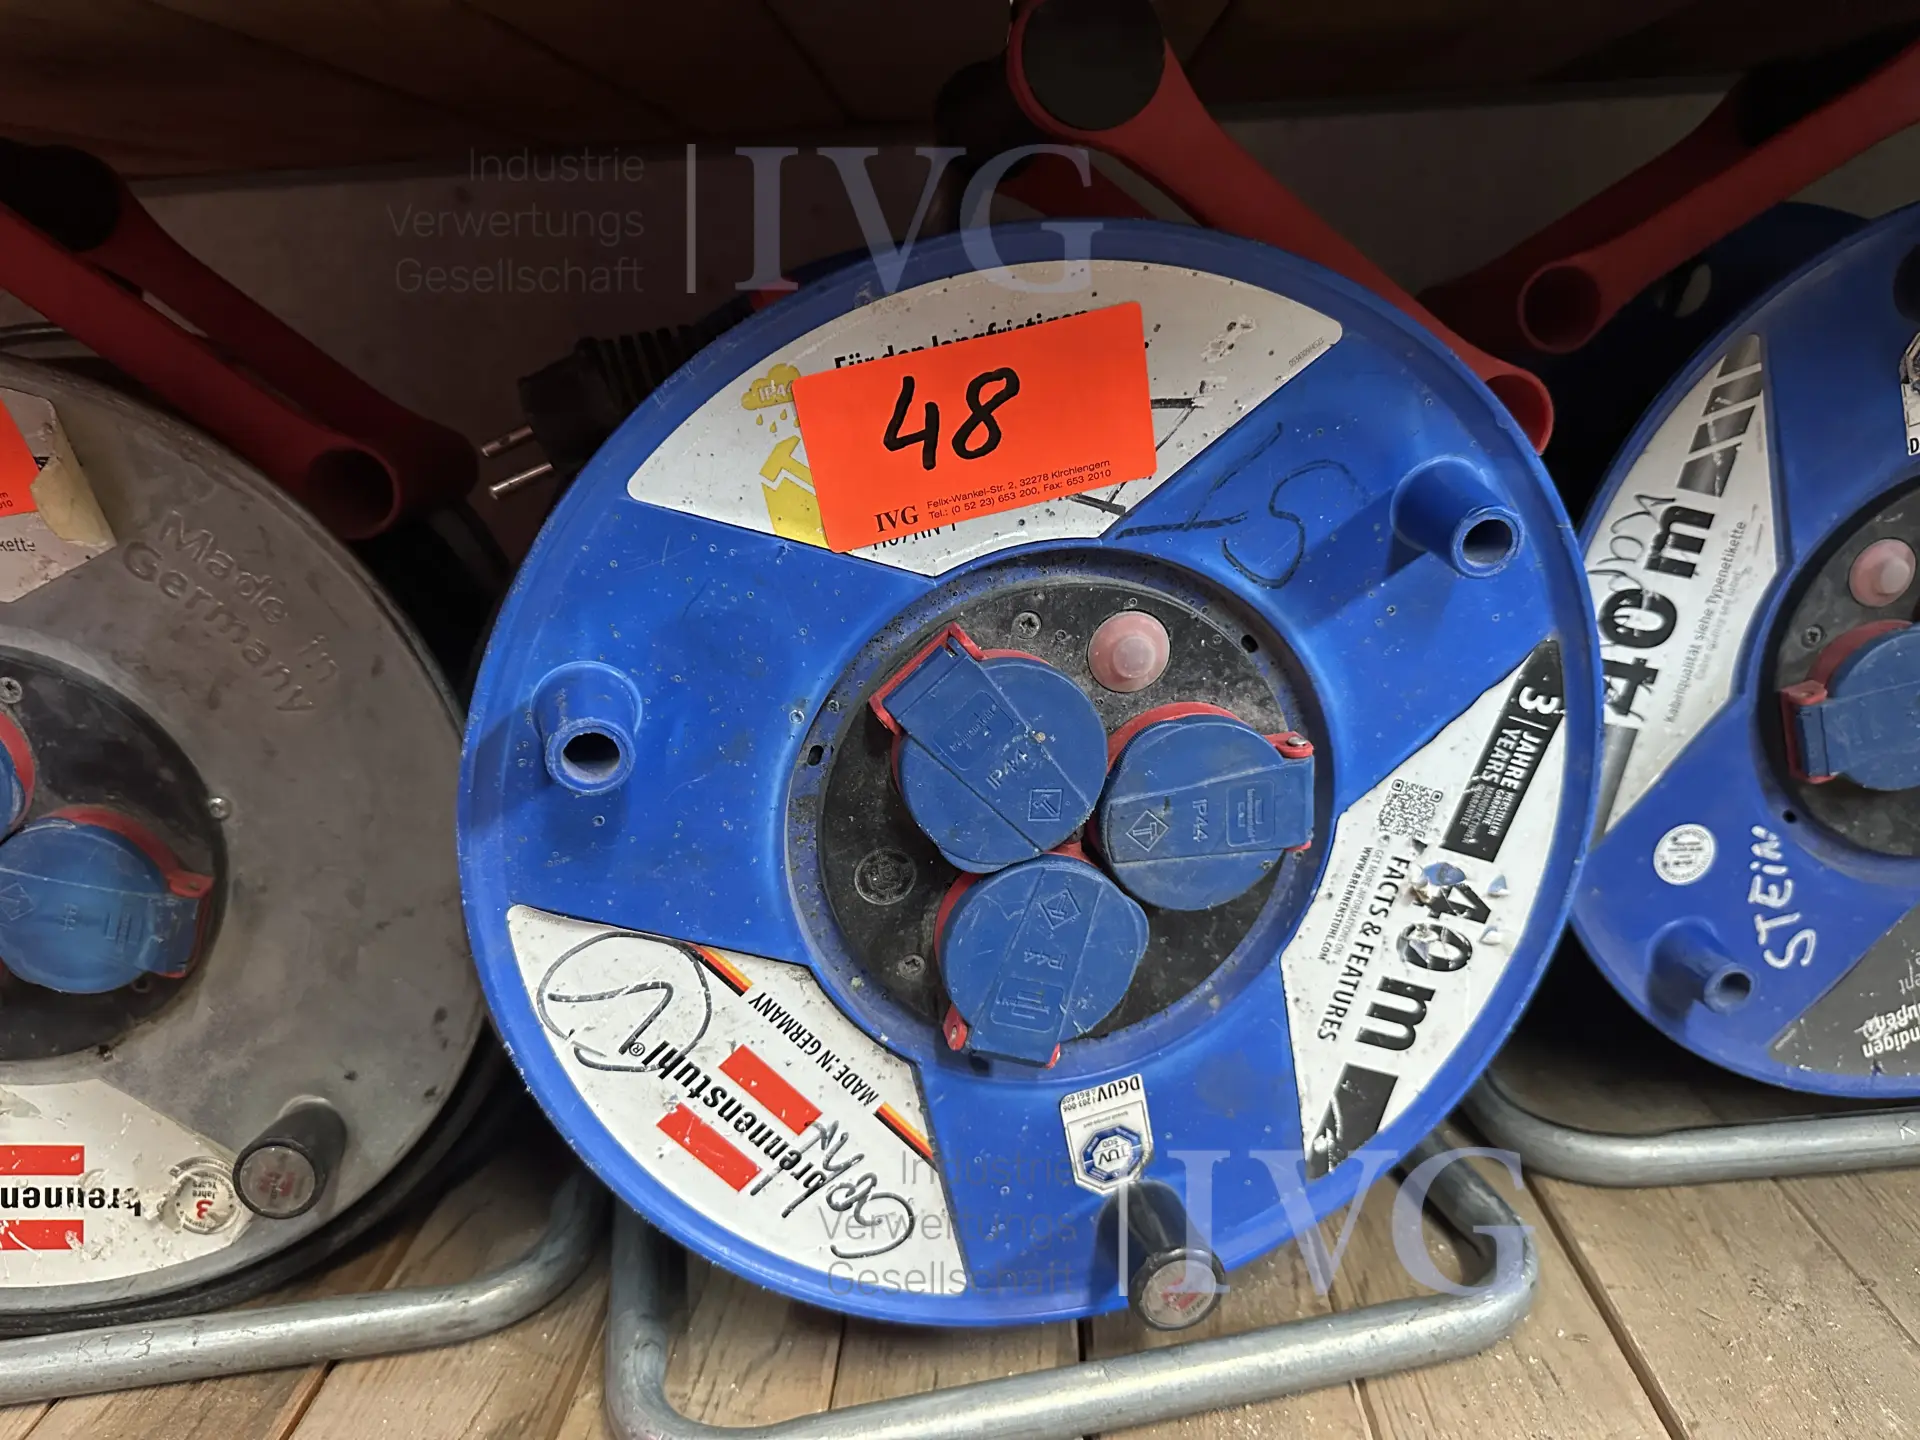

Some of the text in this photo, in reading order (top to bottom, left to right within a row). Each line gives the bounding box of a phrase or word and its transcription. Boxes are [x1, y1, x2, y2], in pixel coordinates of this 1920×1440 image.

[883, 366, 1021, 471] 48
[927, 484, 1006, 509] Felix-Wankel-Str.
[1019, 473, 1049, 487] 32278
[1051, 459, 1111, 480] Kirchlengern
[965, 501, 977, 511] 52
[980, 497, 995, 507] 23)
[998, 492, 1016, 503] 653
[1019, 487, 1040, 498] 200,
[1043, 480, 1063, 492] Fax:
[1066, 475, 1084, 486] 653
[1088, 469, 1112, 481] 2010
[873, 505, 920, 533] IVG
[157, 509, 338, 682] Made in
[1693, 607, 1714, 641] siehe
[1705, 520, 1747, 606] Typenetikette
[123, 540, 315, 711] Germany
[1519, 686, 1558, 715] 3
[1479, 729, 1522, 784] YEARS
[1500, 730, 1542, 790] JAHRE
[1481, 789, 1505, 826] GARANTIE
[1487, 791, 1516, 836] HERSTELLER
[1317, 846, 1374, 961] WWW.BRENNENSTUHL.COM
[1317, 855, 1411, 1042] FACTS & FEATURES
[748, 991, 822, 1056] GERMANY
[1354, 975, 1437, 1052] m
[832, 1064, 880, 1107] MADE
[1097, 1075, 1141, 1102] DGUV
[196, 1199, 214, 1220] 3
